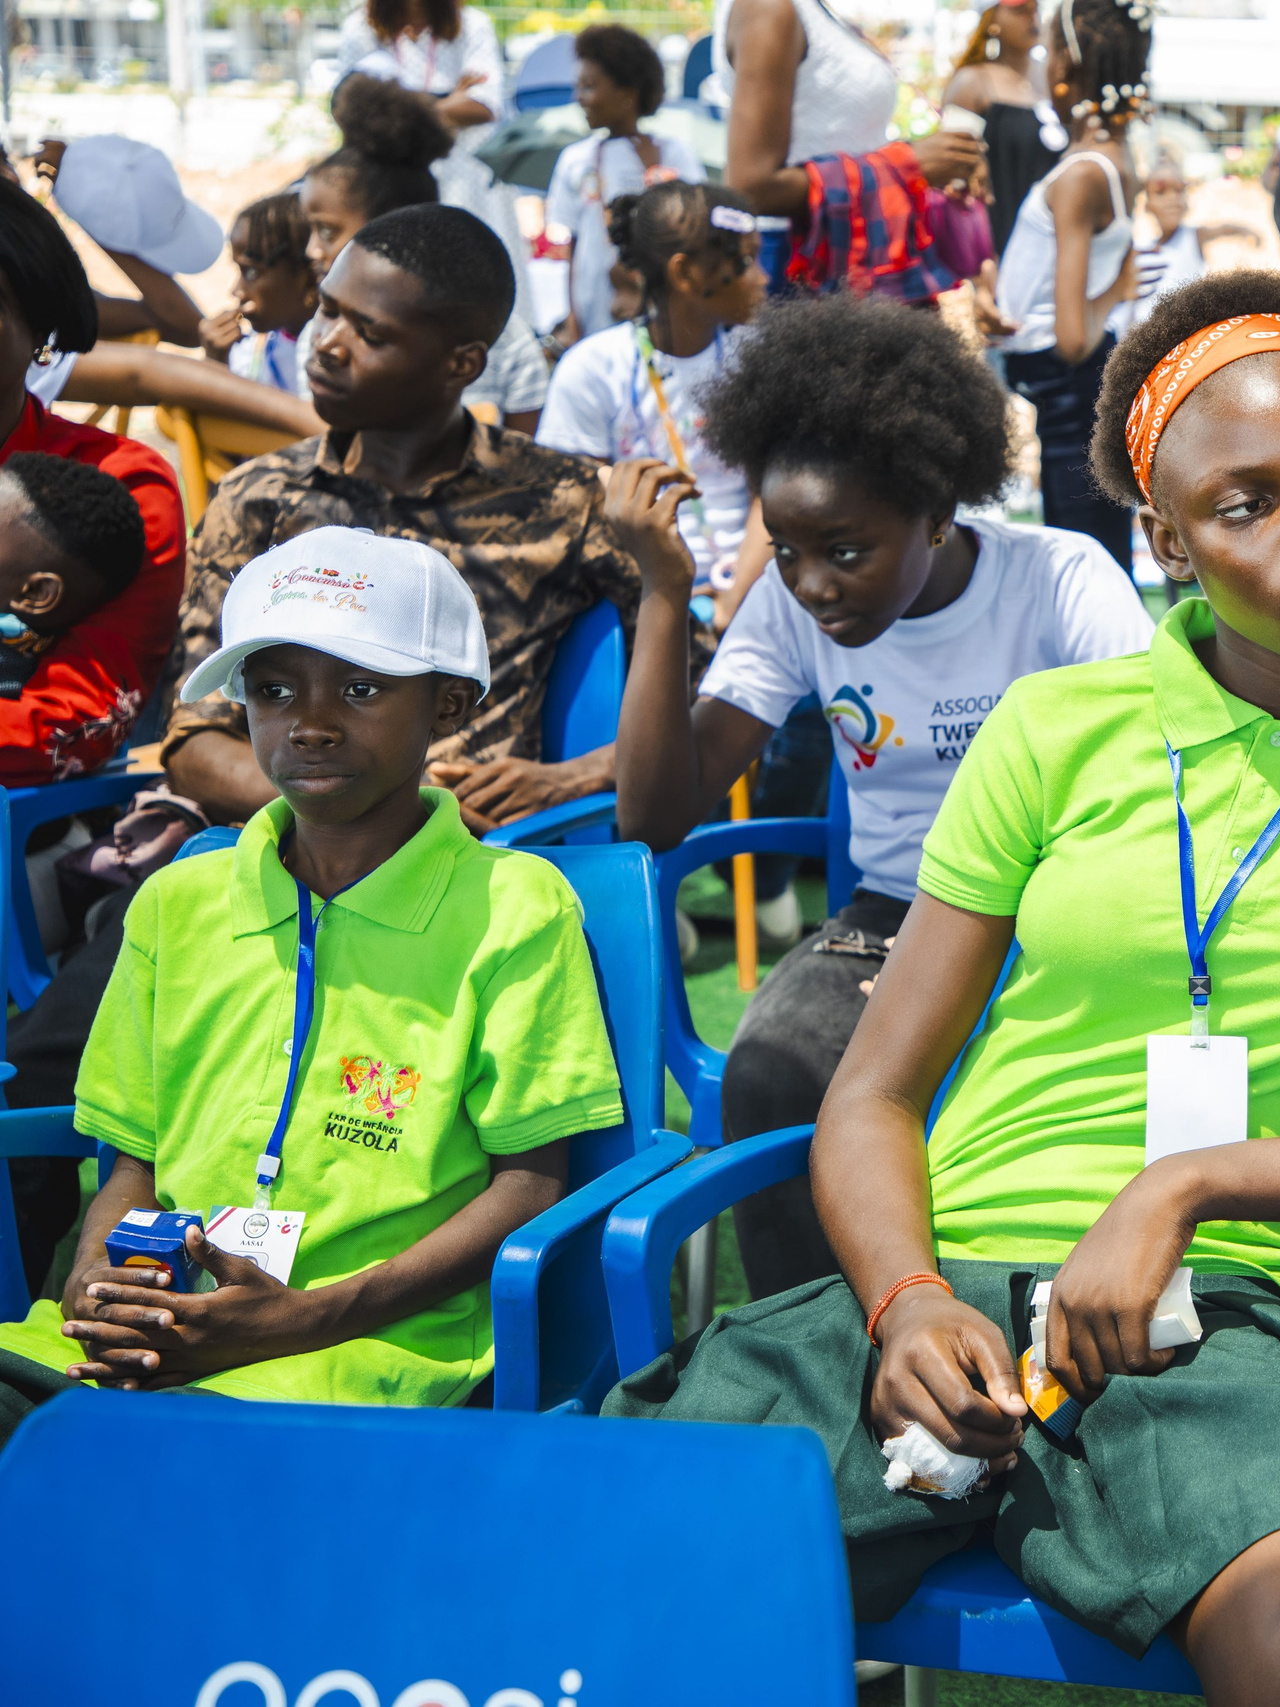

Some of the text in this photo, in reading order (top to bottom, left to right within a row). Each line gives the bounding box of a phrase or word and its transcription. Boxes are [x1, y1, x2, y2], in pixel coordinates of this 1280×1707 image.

[287, 565, 351, 588] Concurso
[928, 720, 984, 743] TWE
[328, 1111, 347, 1122] LAR
[348, 1117, 361, 1127] DE
[324, 1121, 398, 1153] KUZOLA
